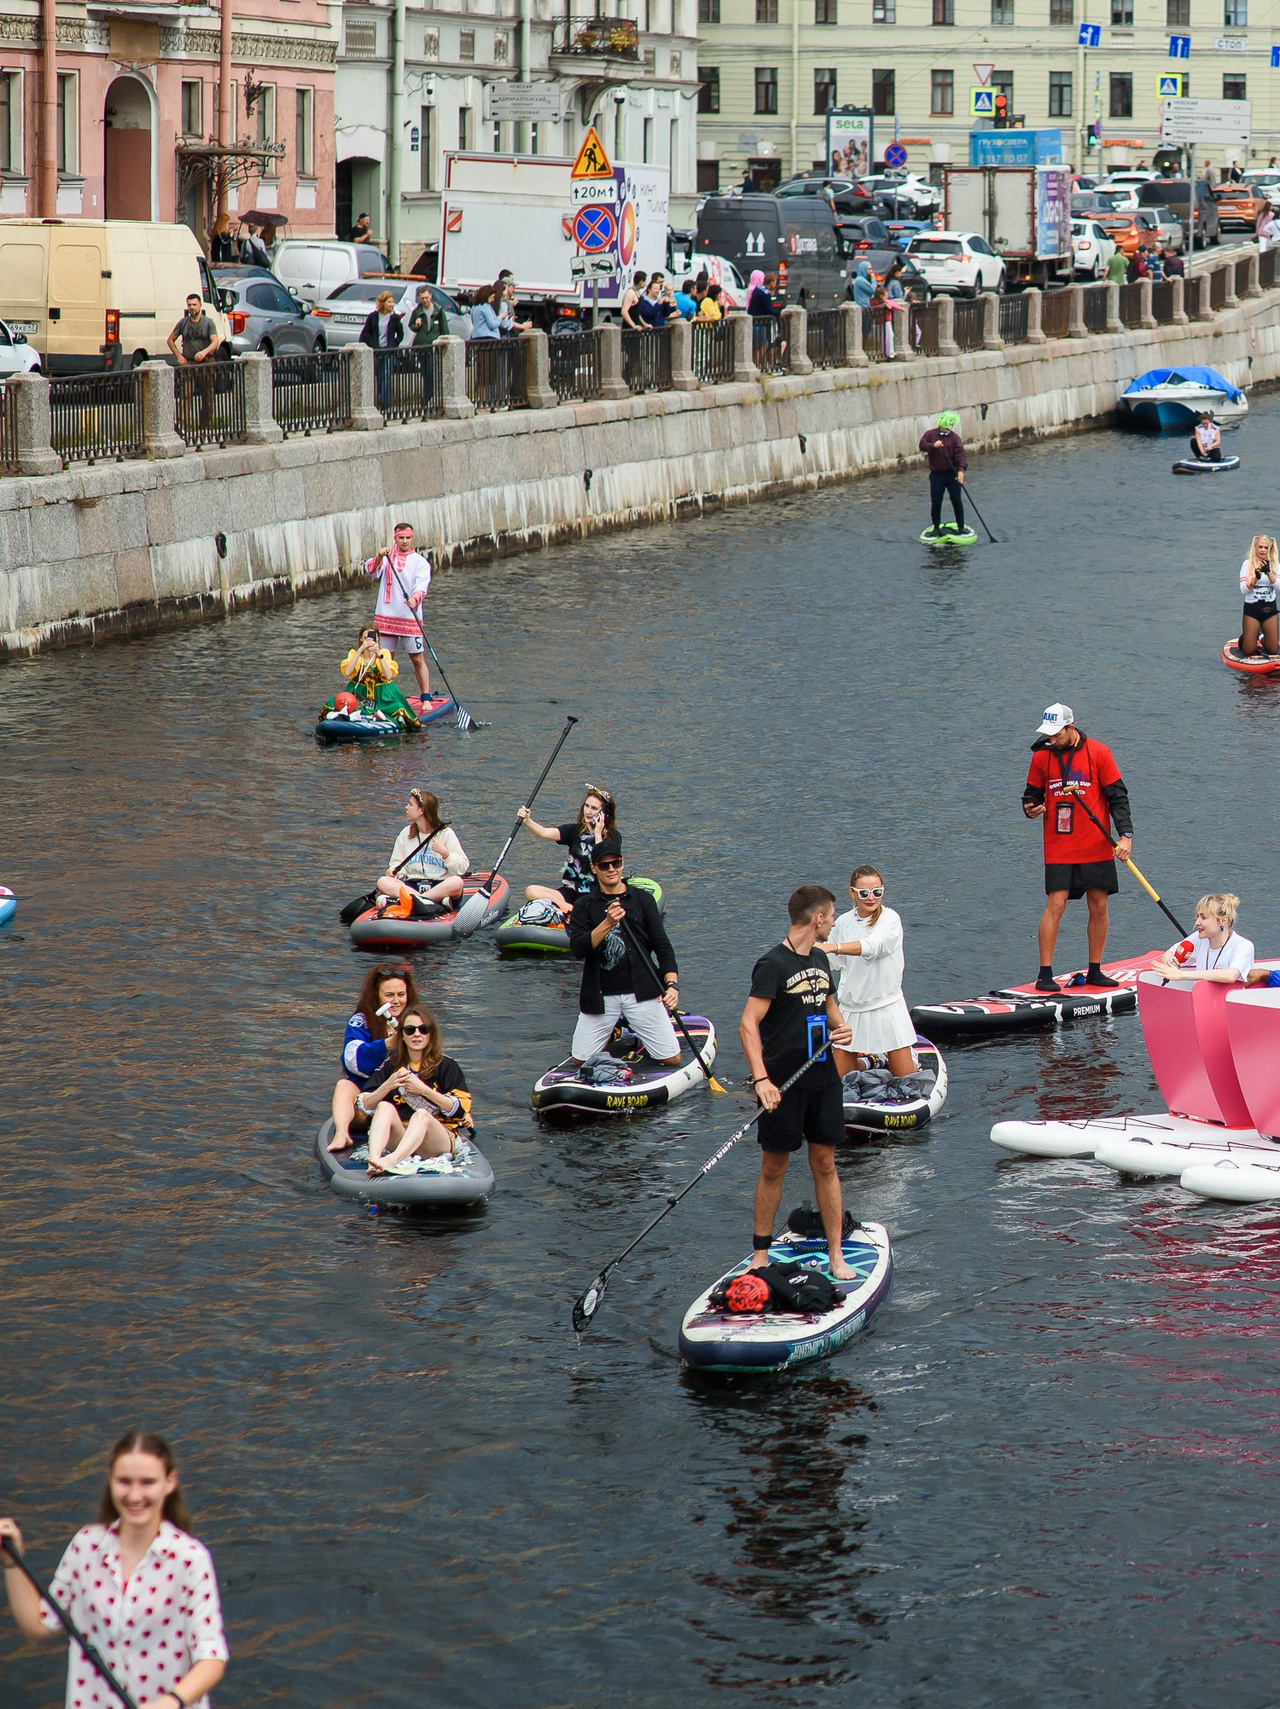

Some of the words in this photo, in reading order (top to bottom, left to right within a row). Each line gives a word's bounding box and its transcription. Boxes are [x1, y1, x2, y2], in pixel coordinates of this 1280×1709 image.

[1217, 40, 1242, 49] СТОП
[1049, 780, 1079, 789] ФОНТНКА
[1073, 1004, 1101, 1016] PREMIUM
[606, 1095, 627, 1108] RAVE
[627, 1094, 649, 1107] BOARD
[884, 1115, 900, 1127] RAVE
